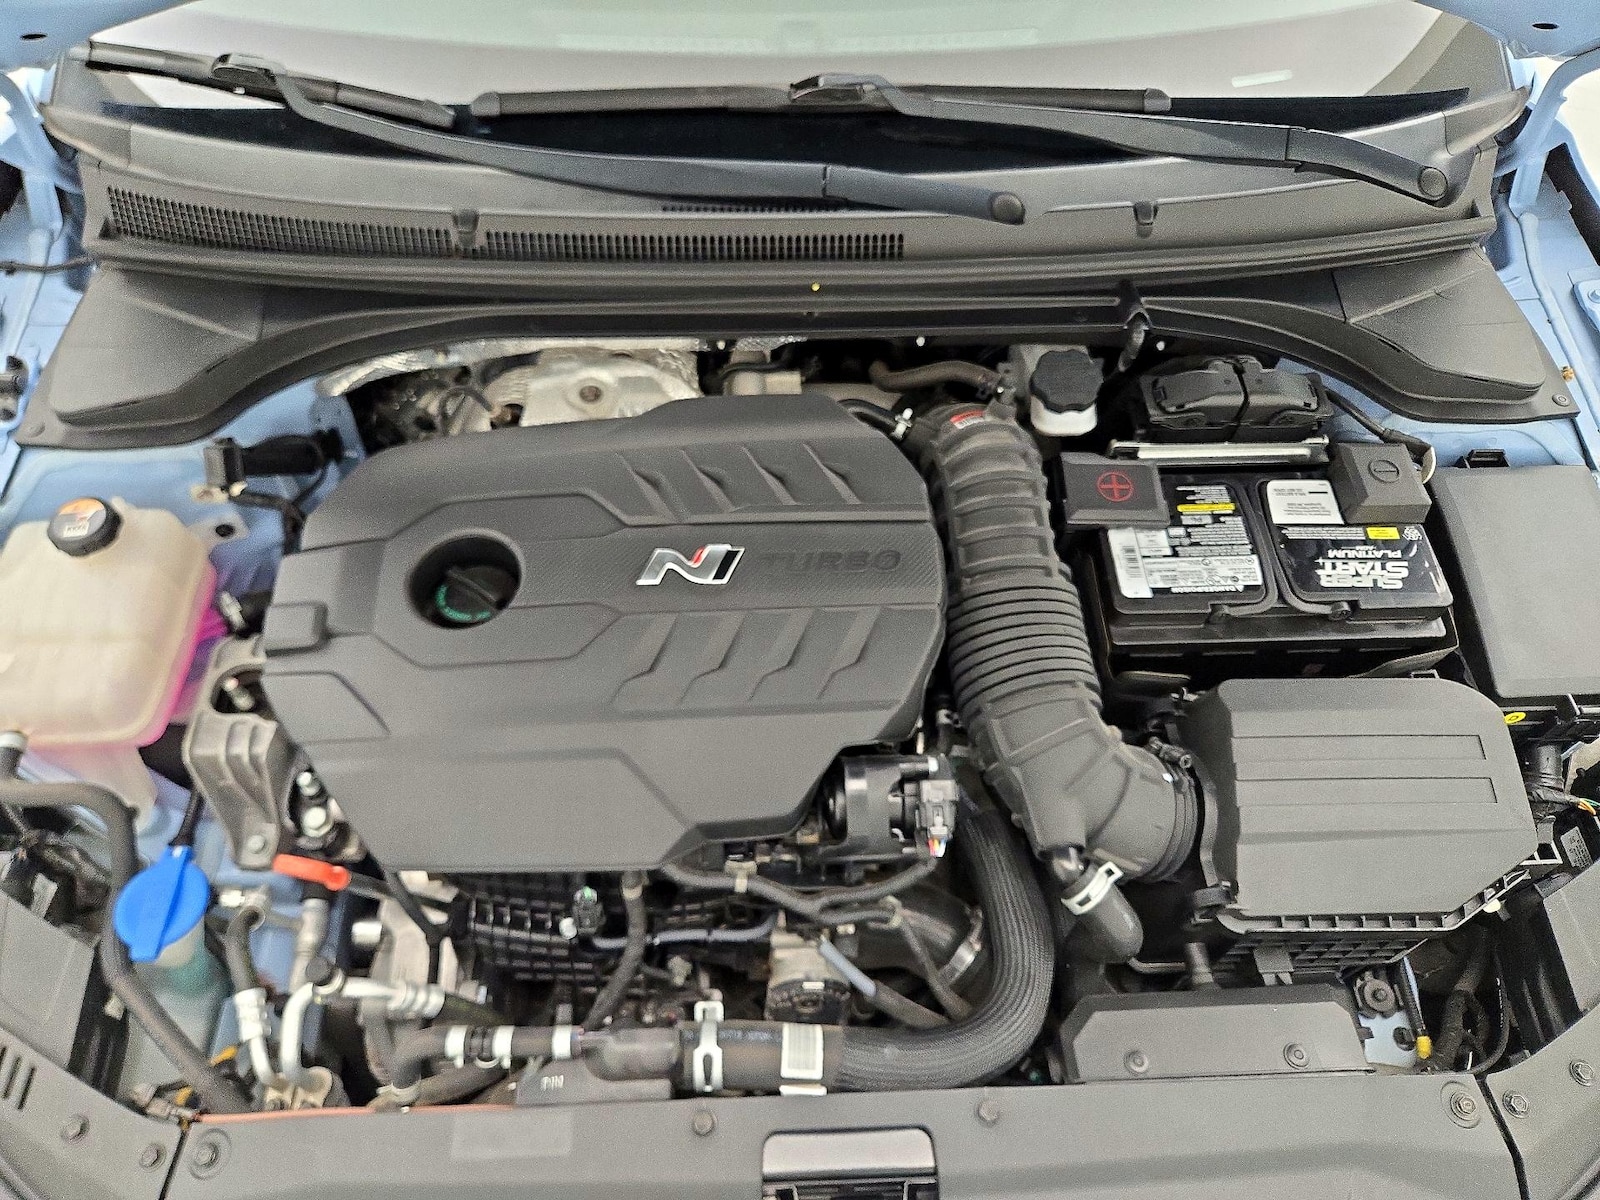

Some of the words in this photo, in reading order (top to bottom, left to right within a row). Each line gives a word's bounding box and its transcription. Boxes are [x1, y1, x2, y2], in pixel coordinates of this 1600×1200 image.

[759, 549, 902, 572] TURBO
[1327, 549, 1402, 559] PLATINUM
[1314, 561, 1409, 578] START
[1320, 576, 1403, 589] SUPER
